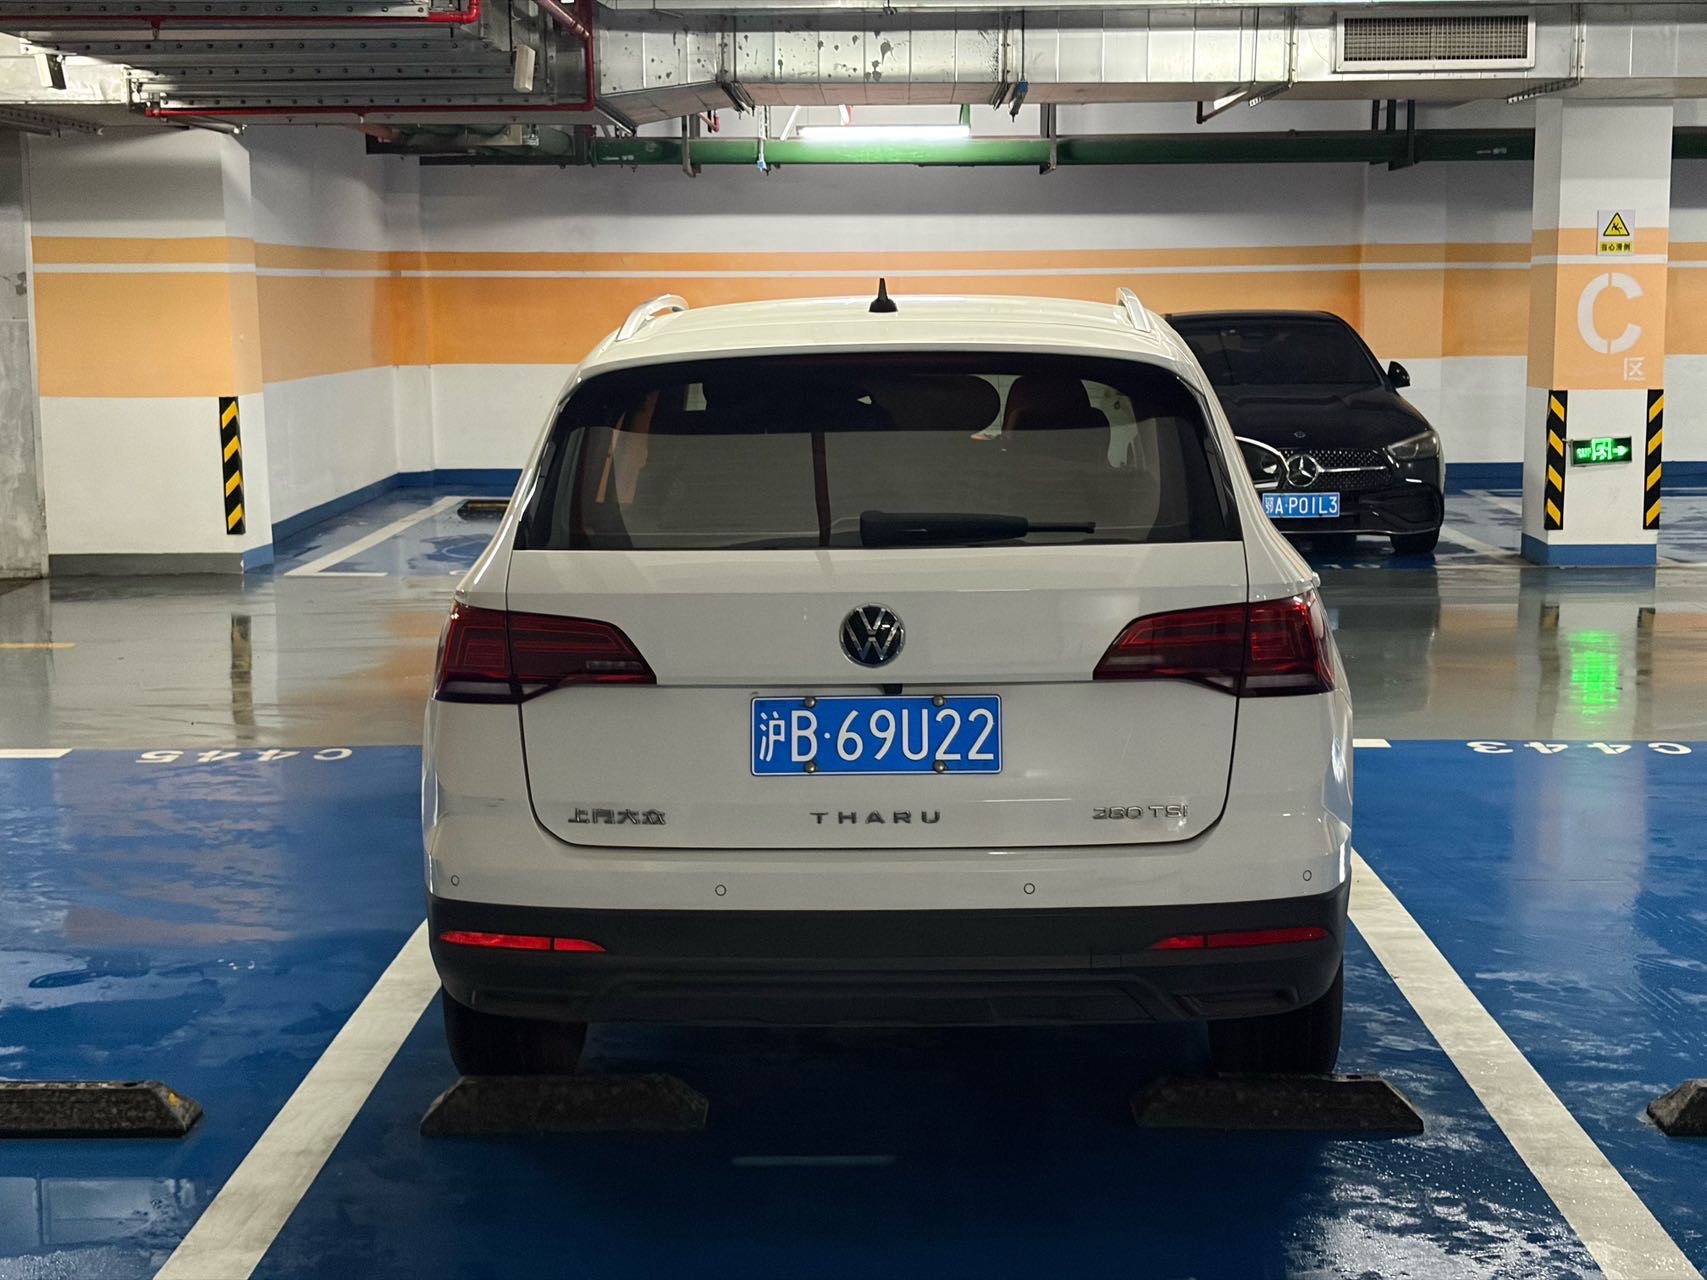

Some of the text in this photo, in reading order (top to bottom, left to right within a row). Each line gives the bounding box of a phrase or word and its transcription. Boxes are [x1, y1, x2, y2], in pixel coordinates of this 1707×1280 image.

[1577, 272, 1643, 354] C
[1623, 357, 1646, 381] 区
[759, 708, 995, 762] 沪B·69U22
[809, 810, 940, 825] THARU
[1148, 804, 1188, 818] TSI
